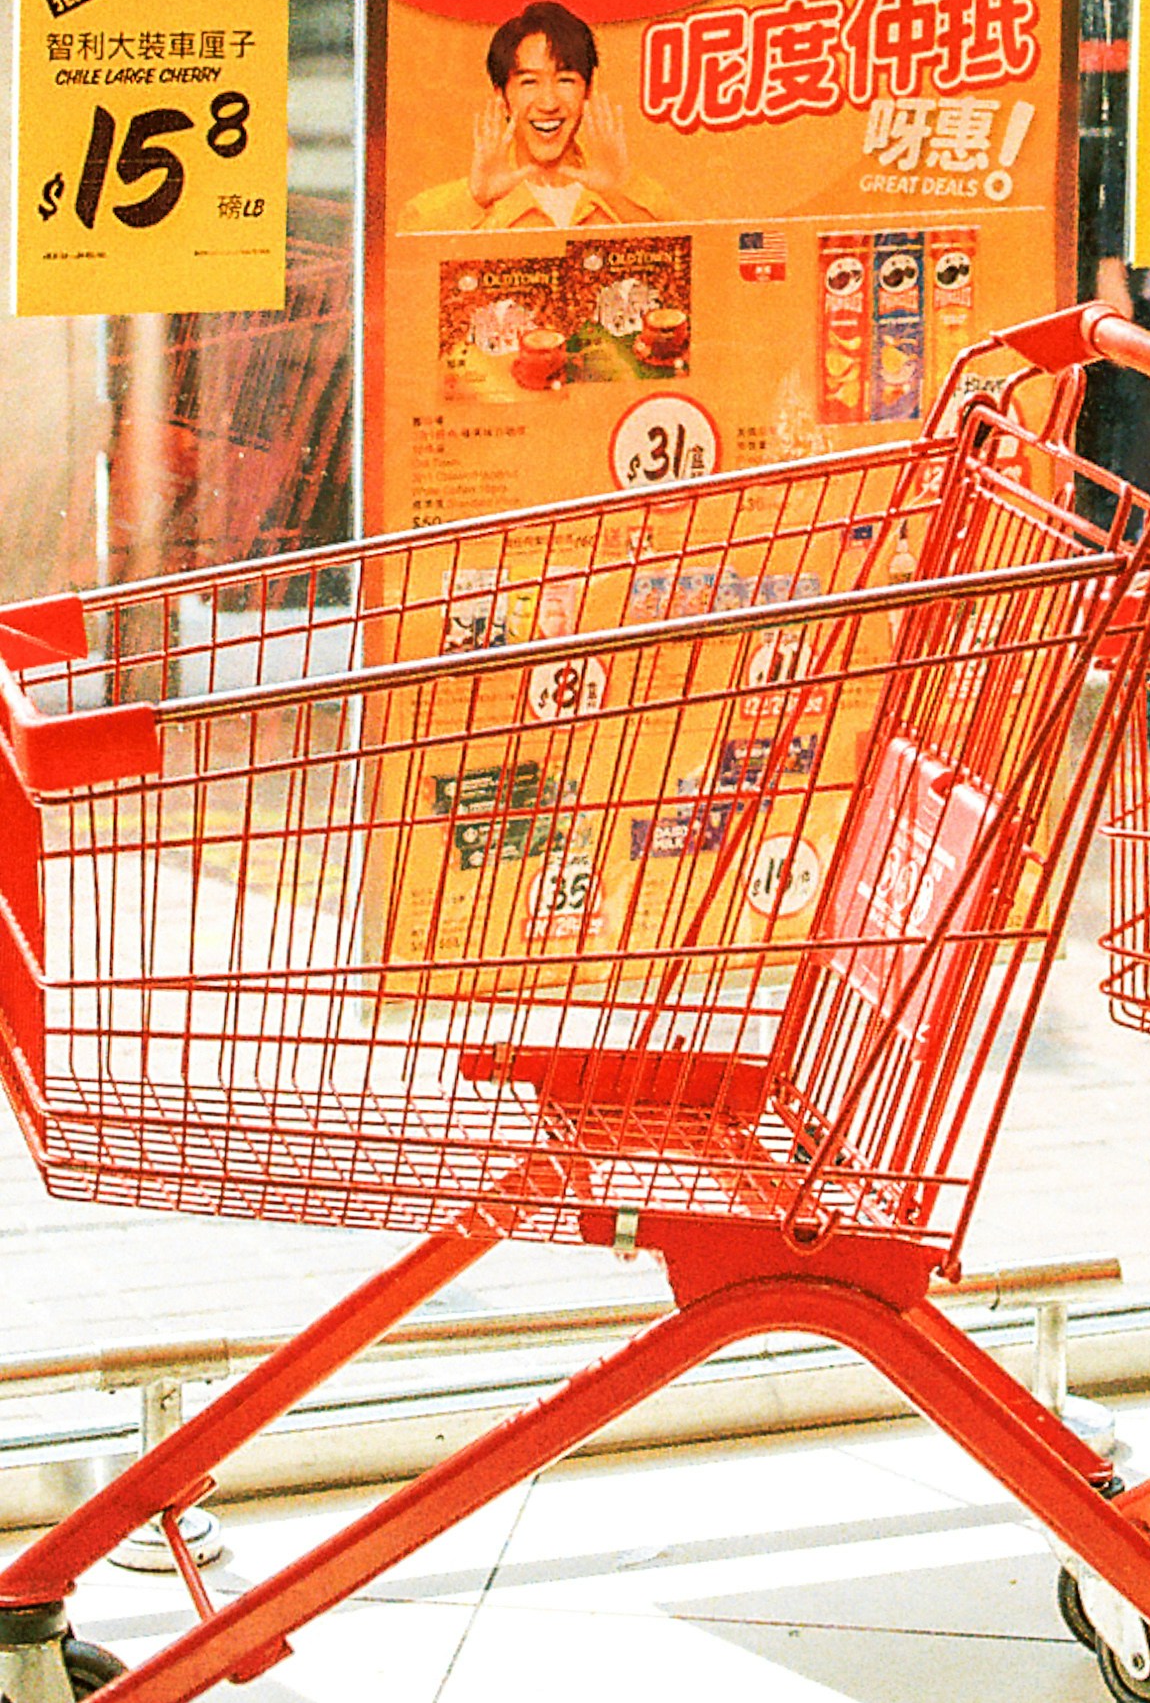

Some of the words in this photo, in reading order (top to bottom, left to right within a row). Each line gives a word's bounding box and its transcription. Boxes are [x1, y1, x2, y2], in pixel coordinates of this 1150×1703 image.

[55, 69, 103, 86] CHILE
[105, 68, 155, 85] LARGE
[159, 66, 221, 83] CHERRY
[859, 173, 920, 195] GREAT
[921, 173, 978, 197] DEALS
